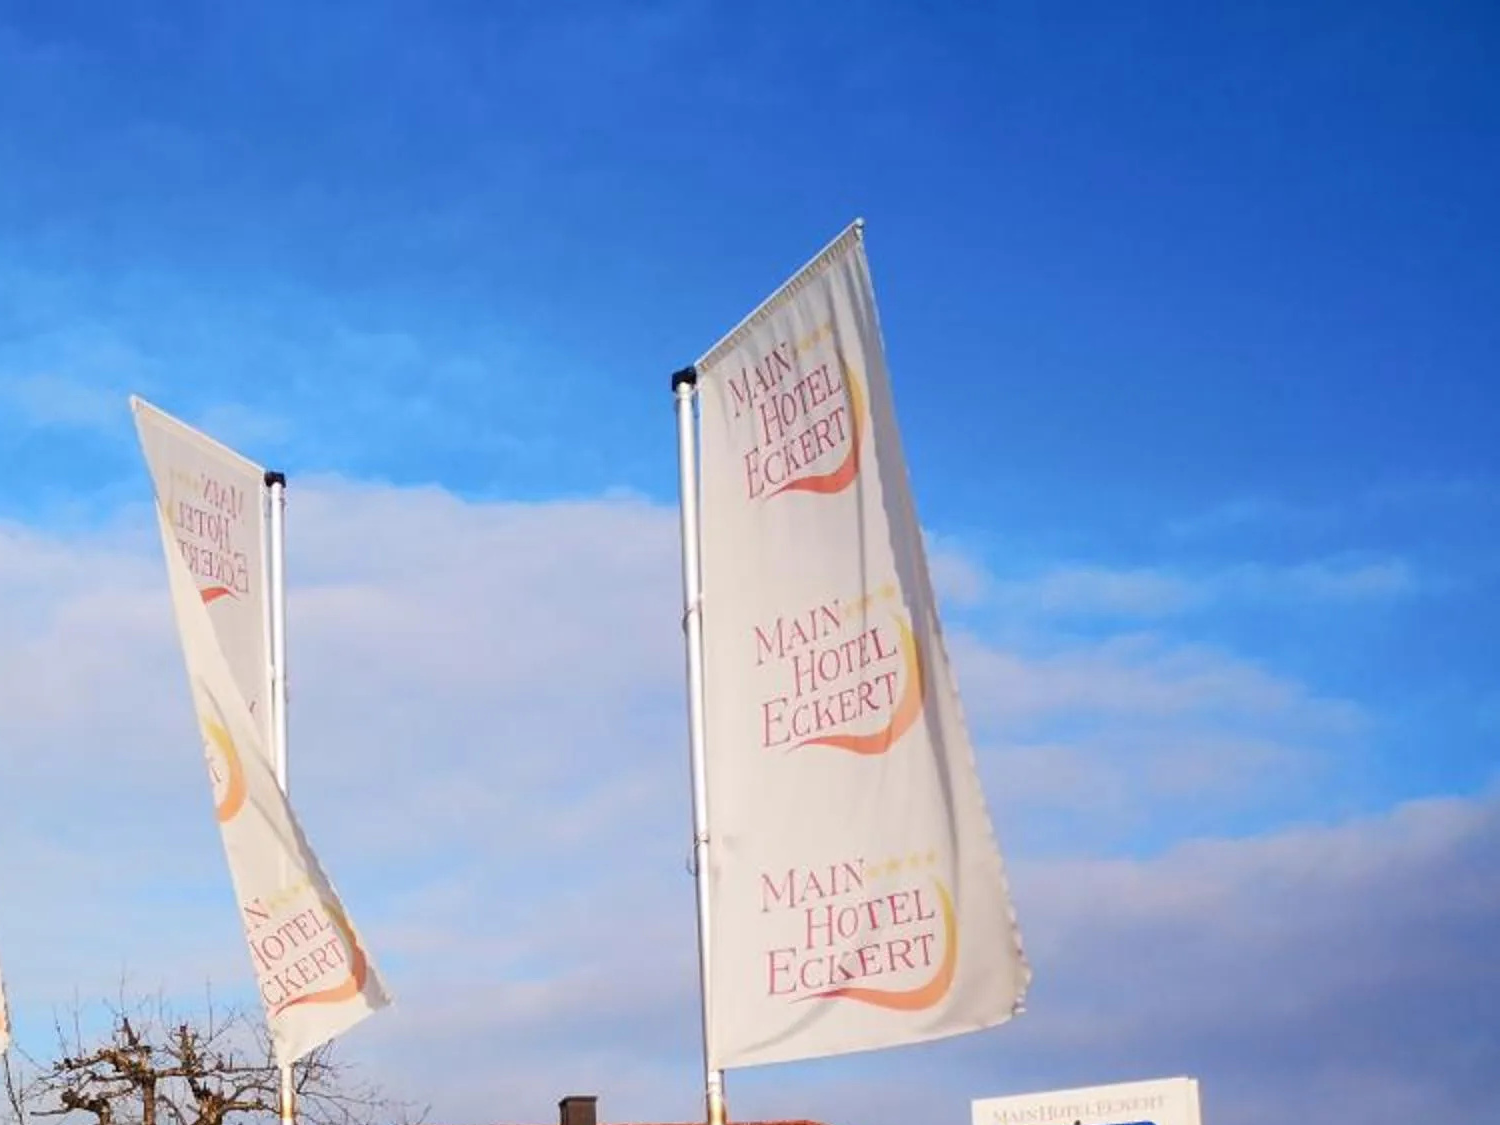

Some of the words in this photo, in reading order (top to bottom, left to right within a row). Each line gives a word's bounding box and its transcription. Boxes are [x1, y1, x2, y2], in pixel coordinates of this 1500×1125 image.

[728, 342, 792, 418] MAIN
[759, 363, 843, 446] HOTEL
[744, 407, 846, 500] ECKERT
[754, 598, 841, 666] MAIN
[792, 626, 897, 697] HOTEL
[762, 671, 898, 748] ECKERT
[761, 858, 865, 913] MAIN
[805, 889, 935, 949] HOTEL
[260, 937, 345, 1006] CKERT
[767, 934, 935, 996] ECKERT
